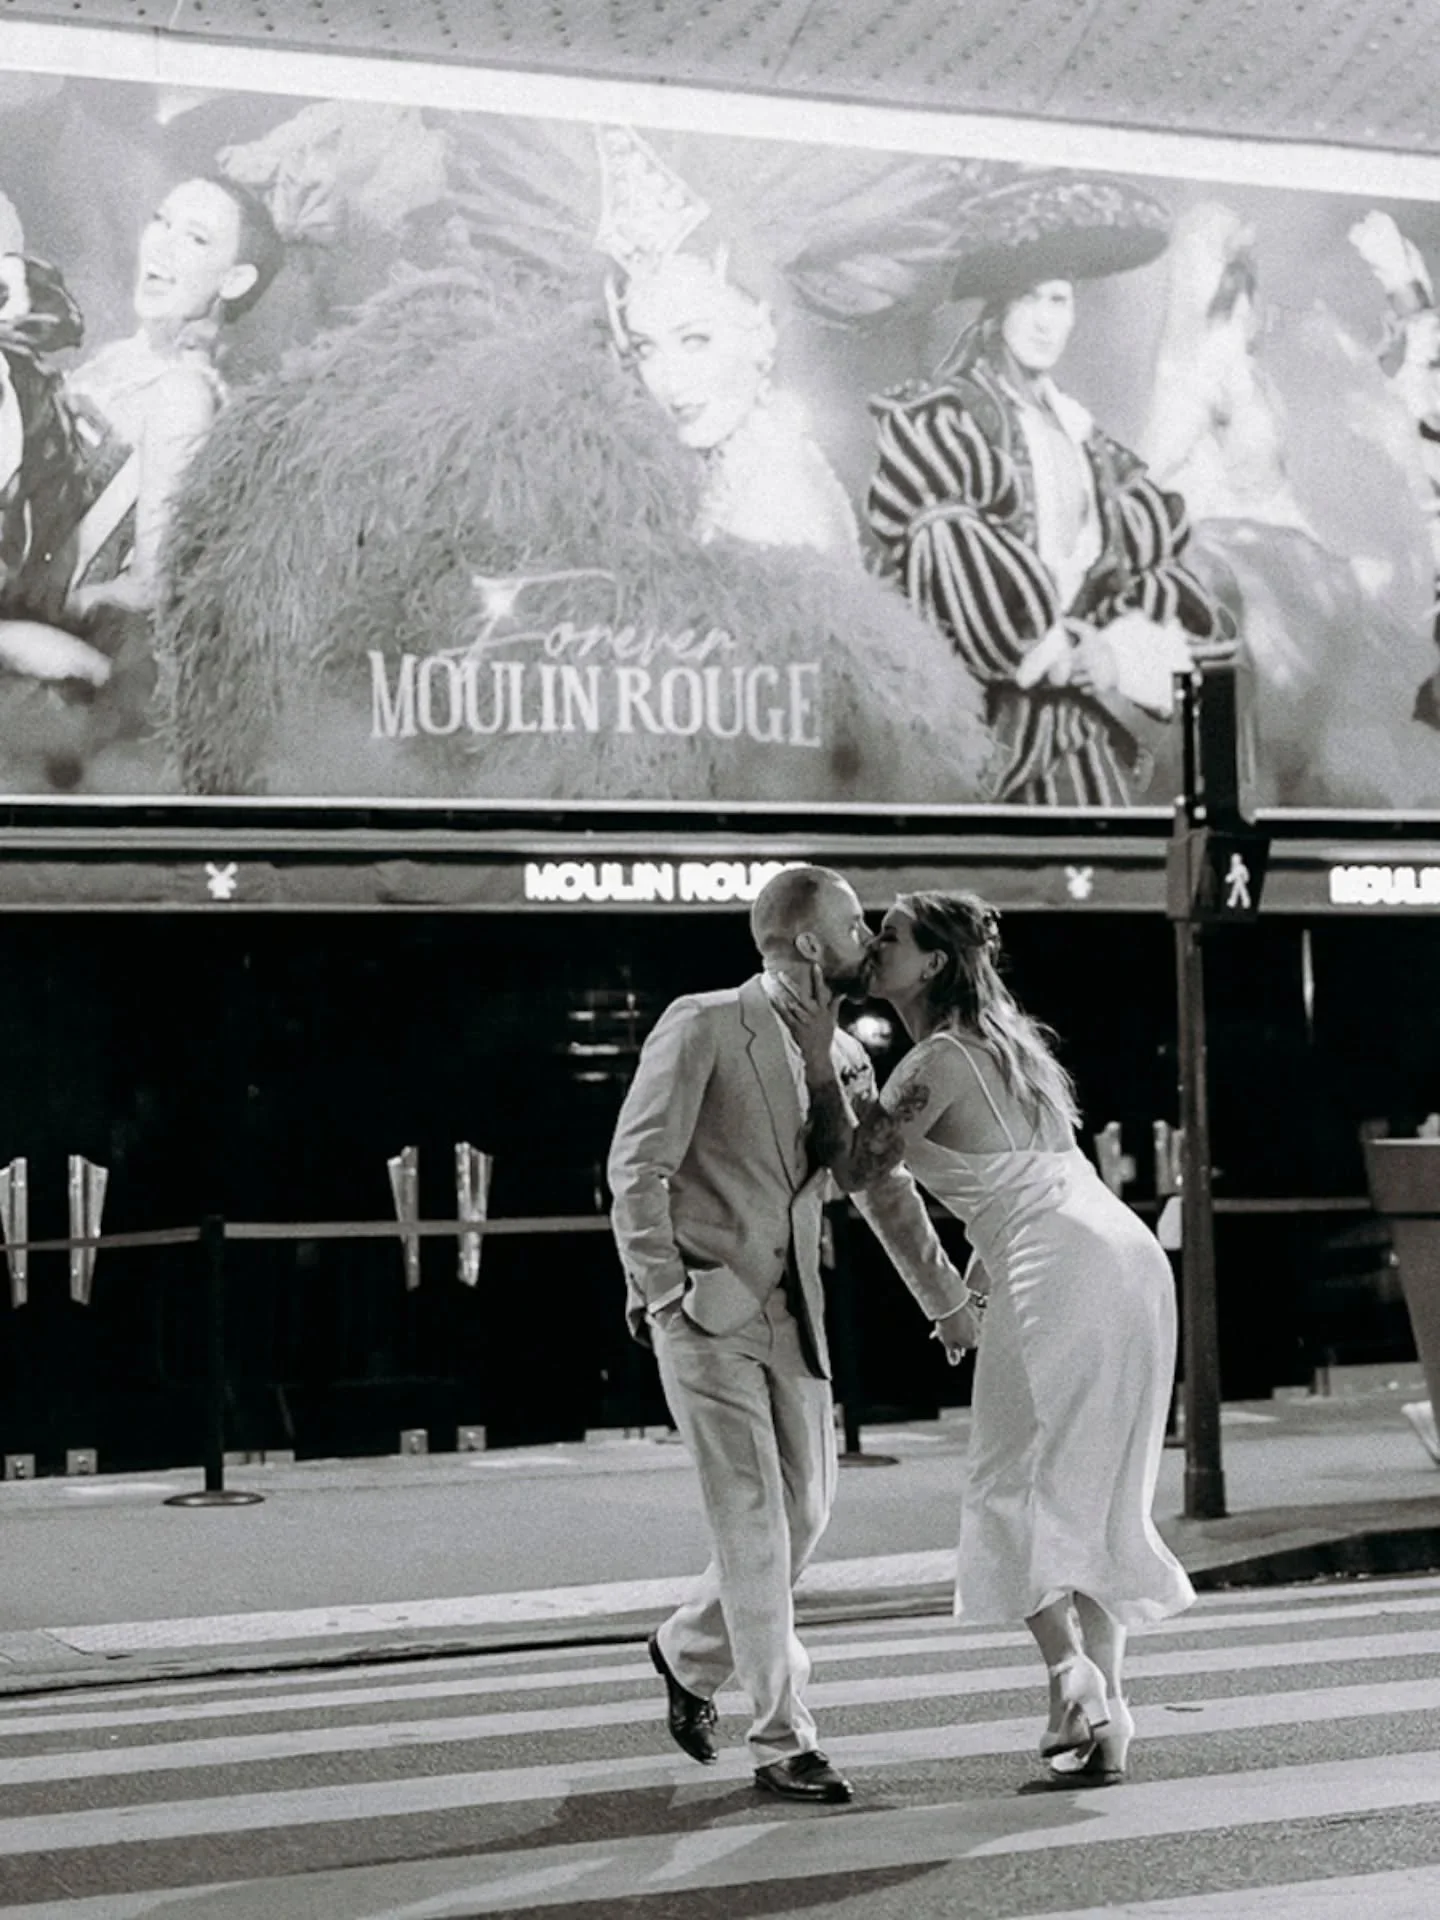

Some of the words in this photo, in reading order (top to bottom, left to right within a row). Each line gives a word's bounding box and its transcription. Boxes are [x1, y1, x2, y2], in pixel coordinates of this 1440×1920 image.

[437, 568, 738, 678] Forever
[367, 649, 601, 738] MOULIN
[616, 661, 822, 748] ROUGE
[525, 862, 674, 901] MOULIN
[679, 861, 812, 901] ROU
